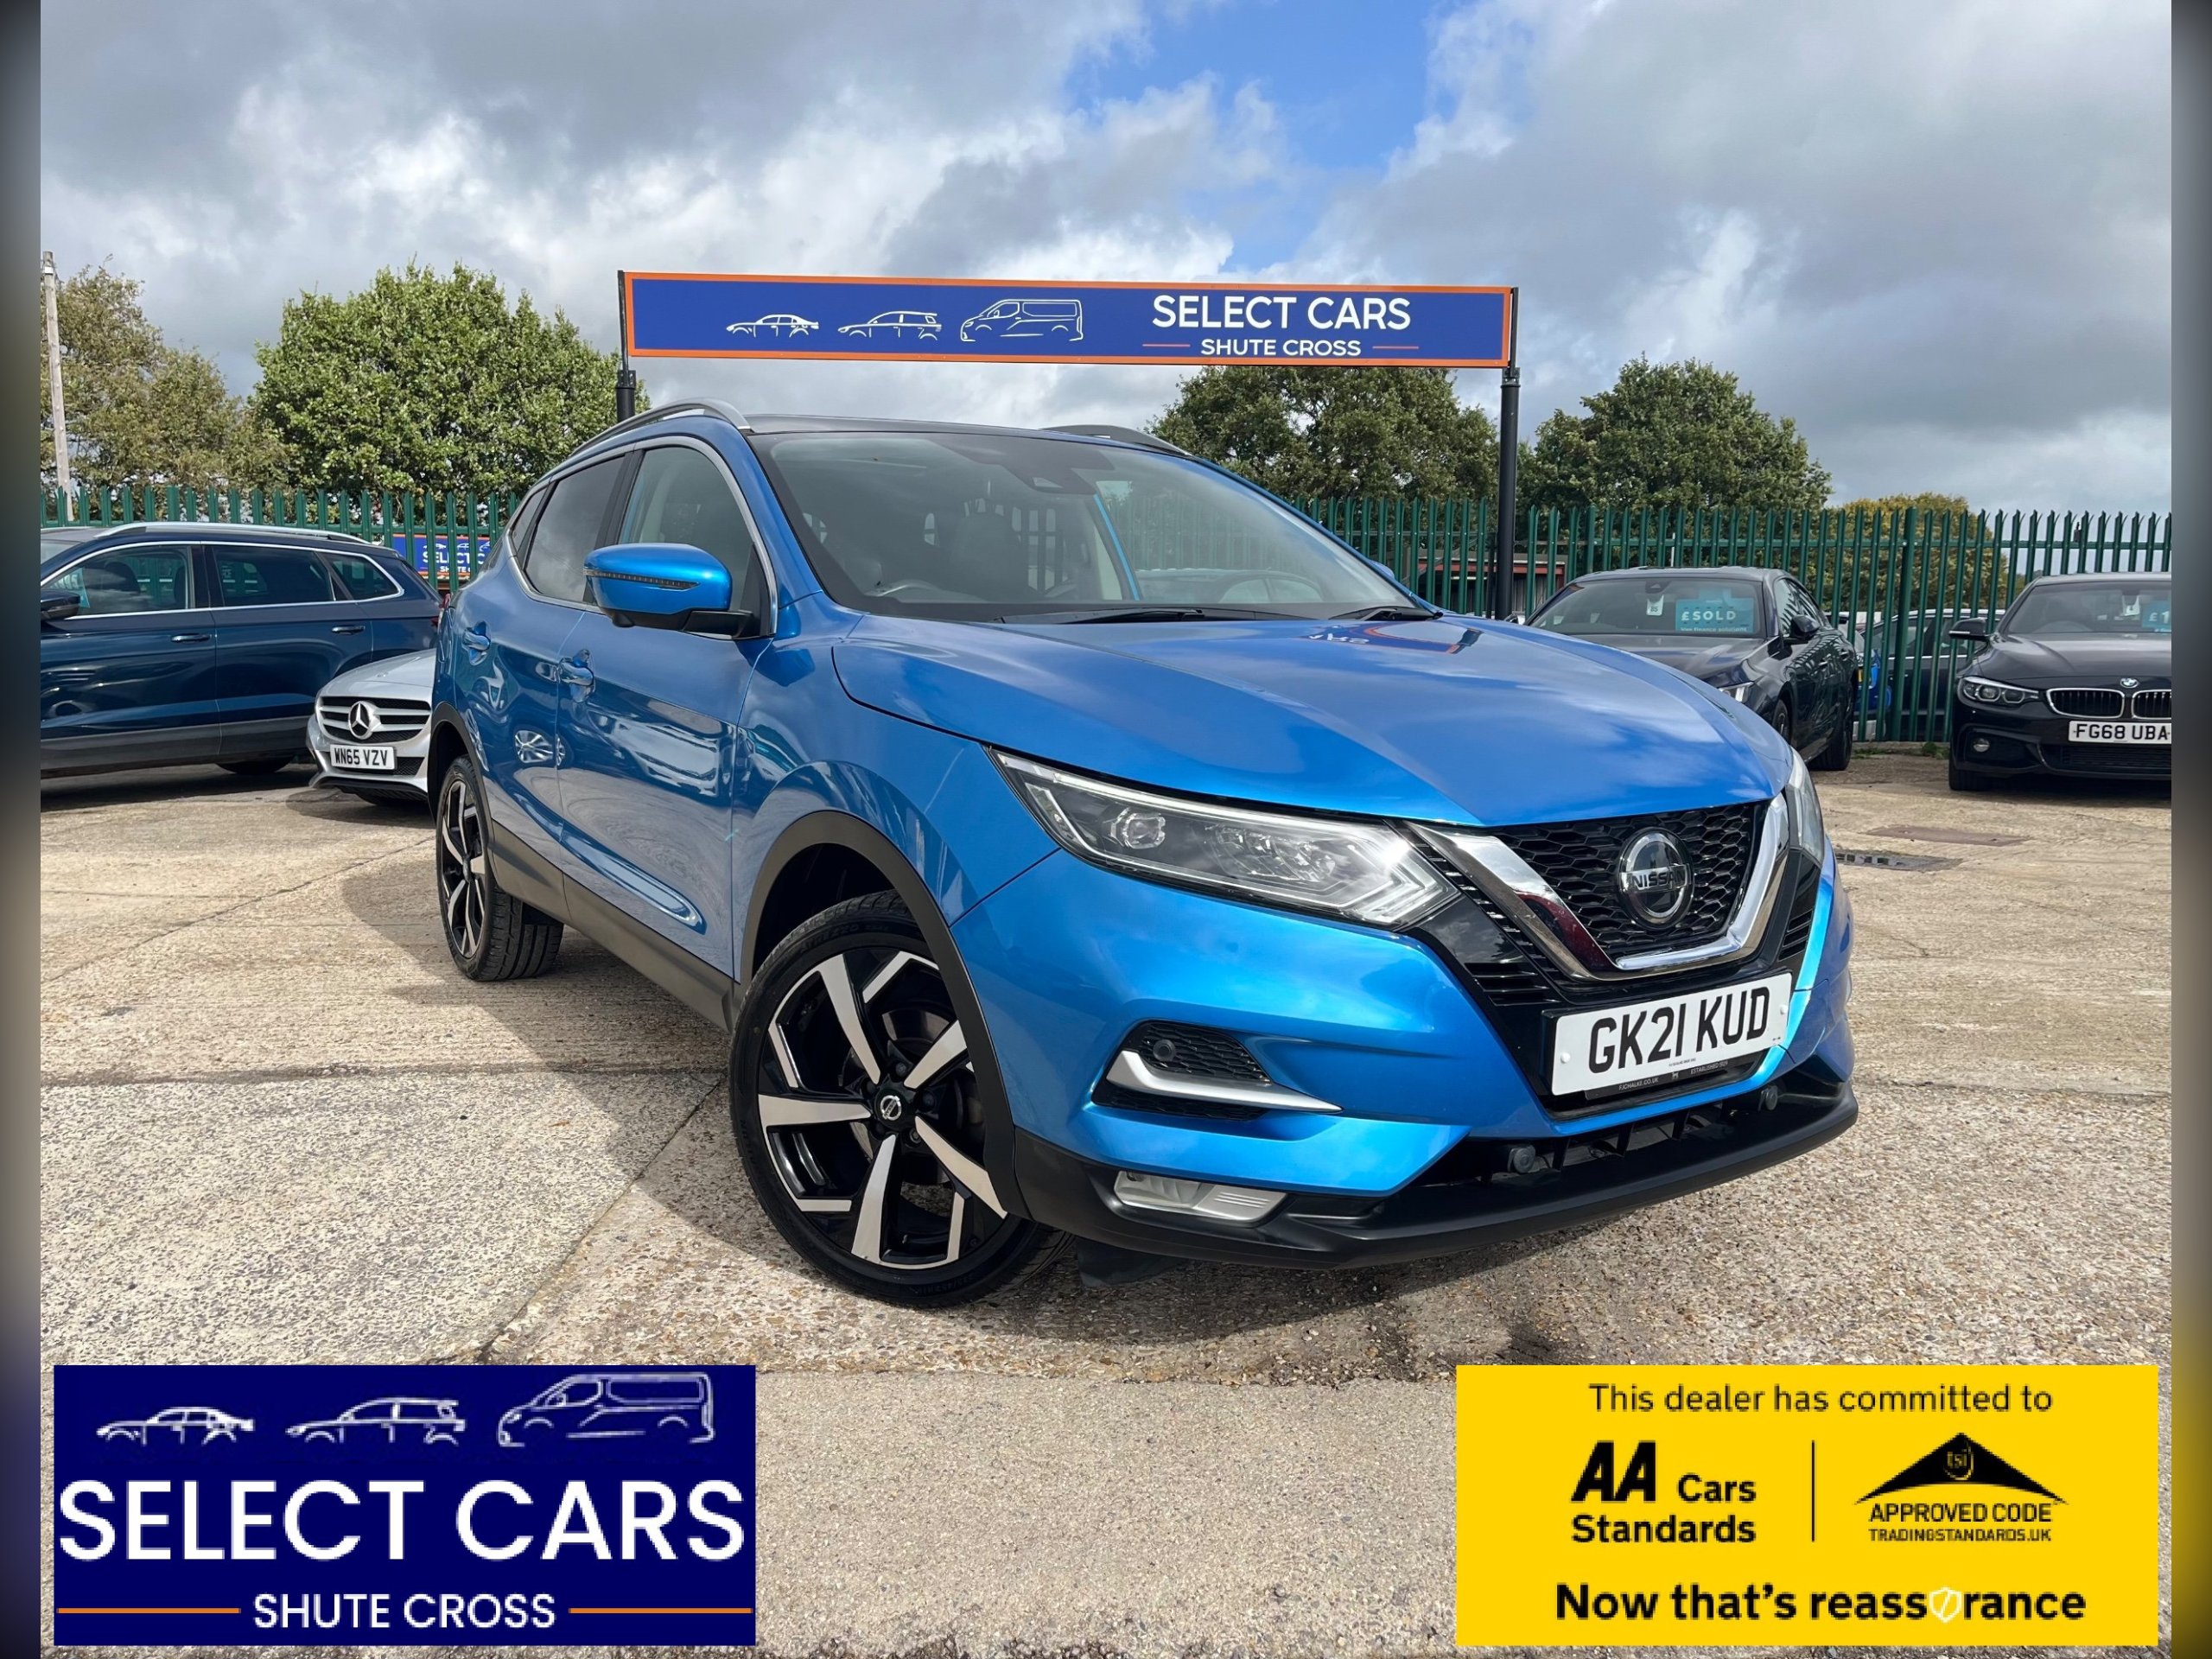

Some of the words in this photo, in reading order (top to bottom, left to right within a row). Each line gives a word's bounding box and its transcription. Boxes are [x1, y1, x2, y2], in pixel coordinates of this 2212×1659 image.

[1152, 295, 1297, 329] SELECT
[1307, 296, 1411, 330] CARS
[1201, 339, 1276, 356] SHUTE
[1282, 340, 1361, 356] CROSS
[423, 551, 470, 564] SELCT
[2075, 723, 2126, 740] FG68
[2132, 725, 2168, 741] UBA
[334, 747, 360, 765] WN65
[363, 749, 388, 766] VZV
[1631, 869, 1686, 889] NISSAN
[1588, 1003, 1687, 1074] GK21
[1695, 986, 1770, 1052] KUD
[1690, 1062, 1719, 1075] ESTABLISHED
